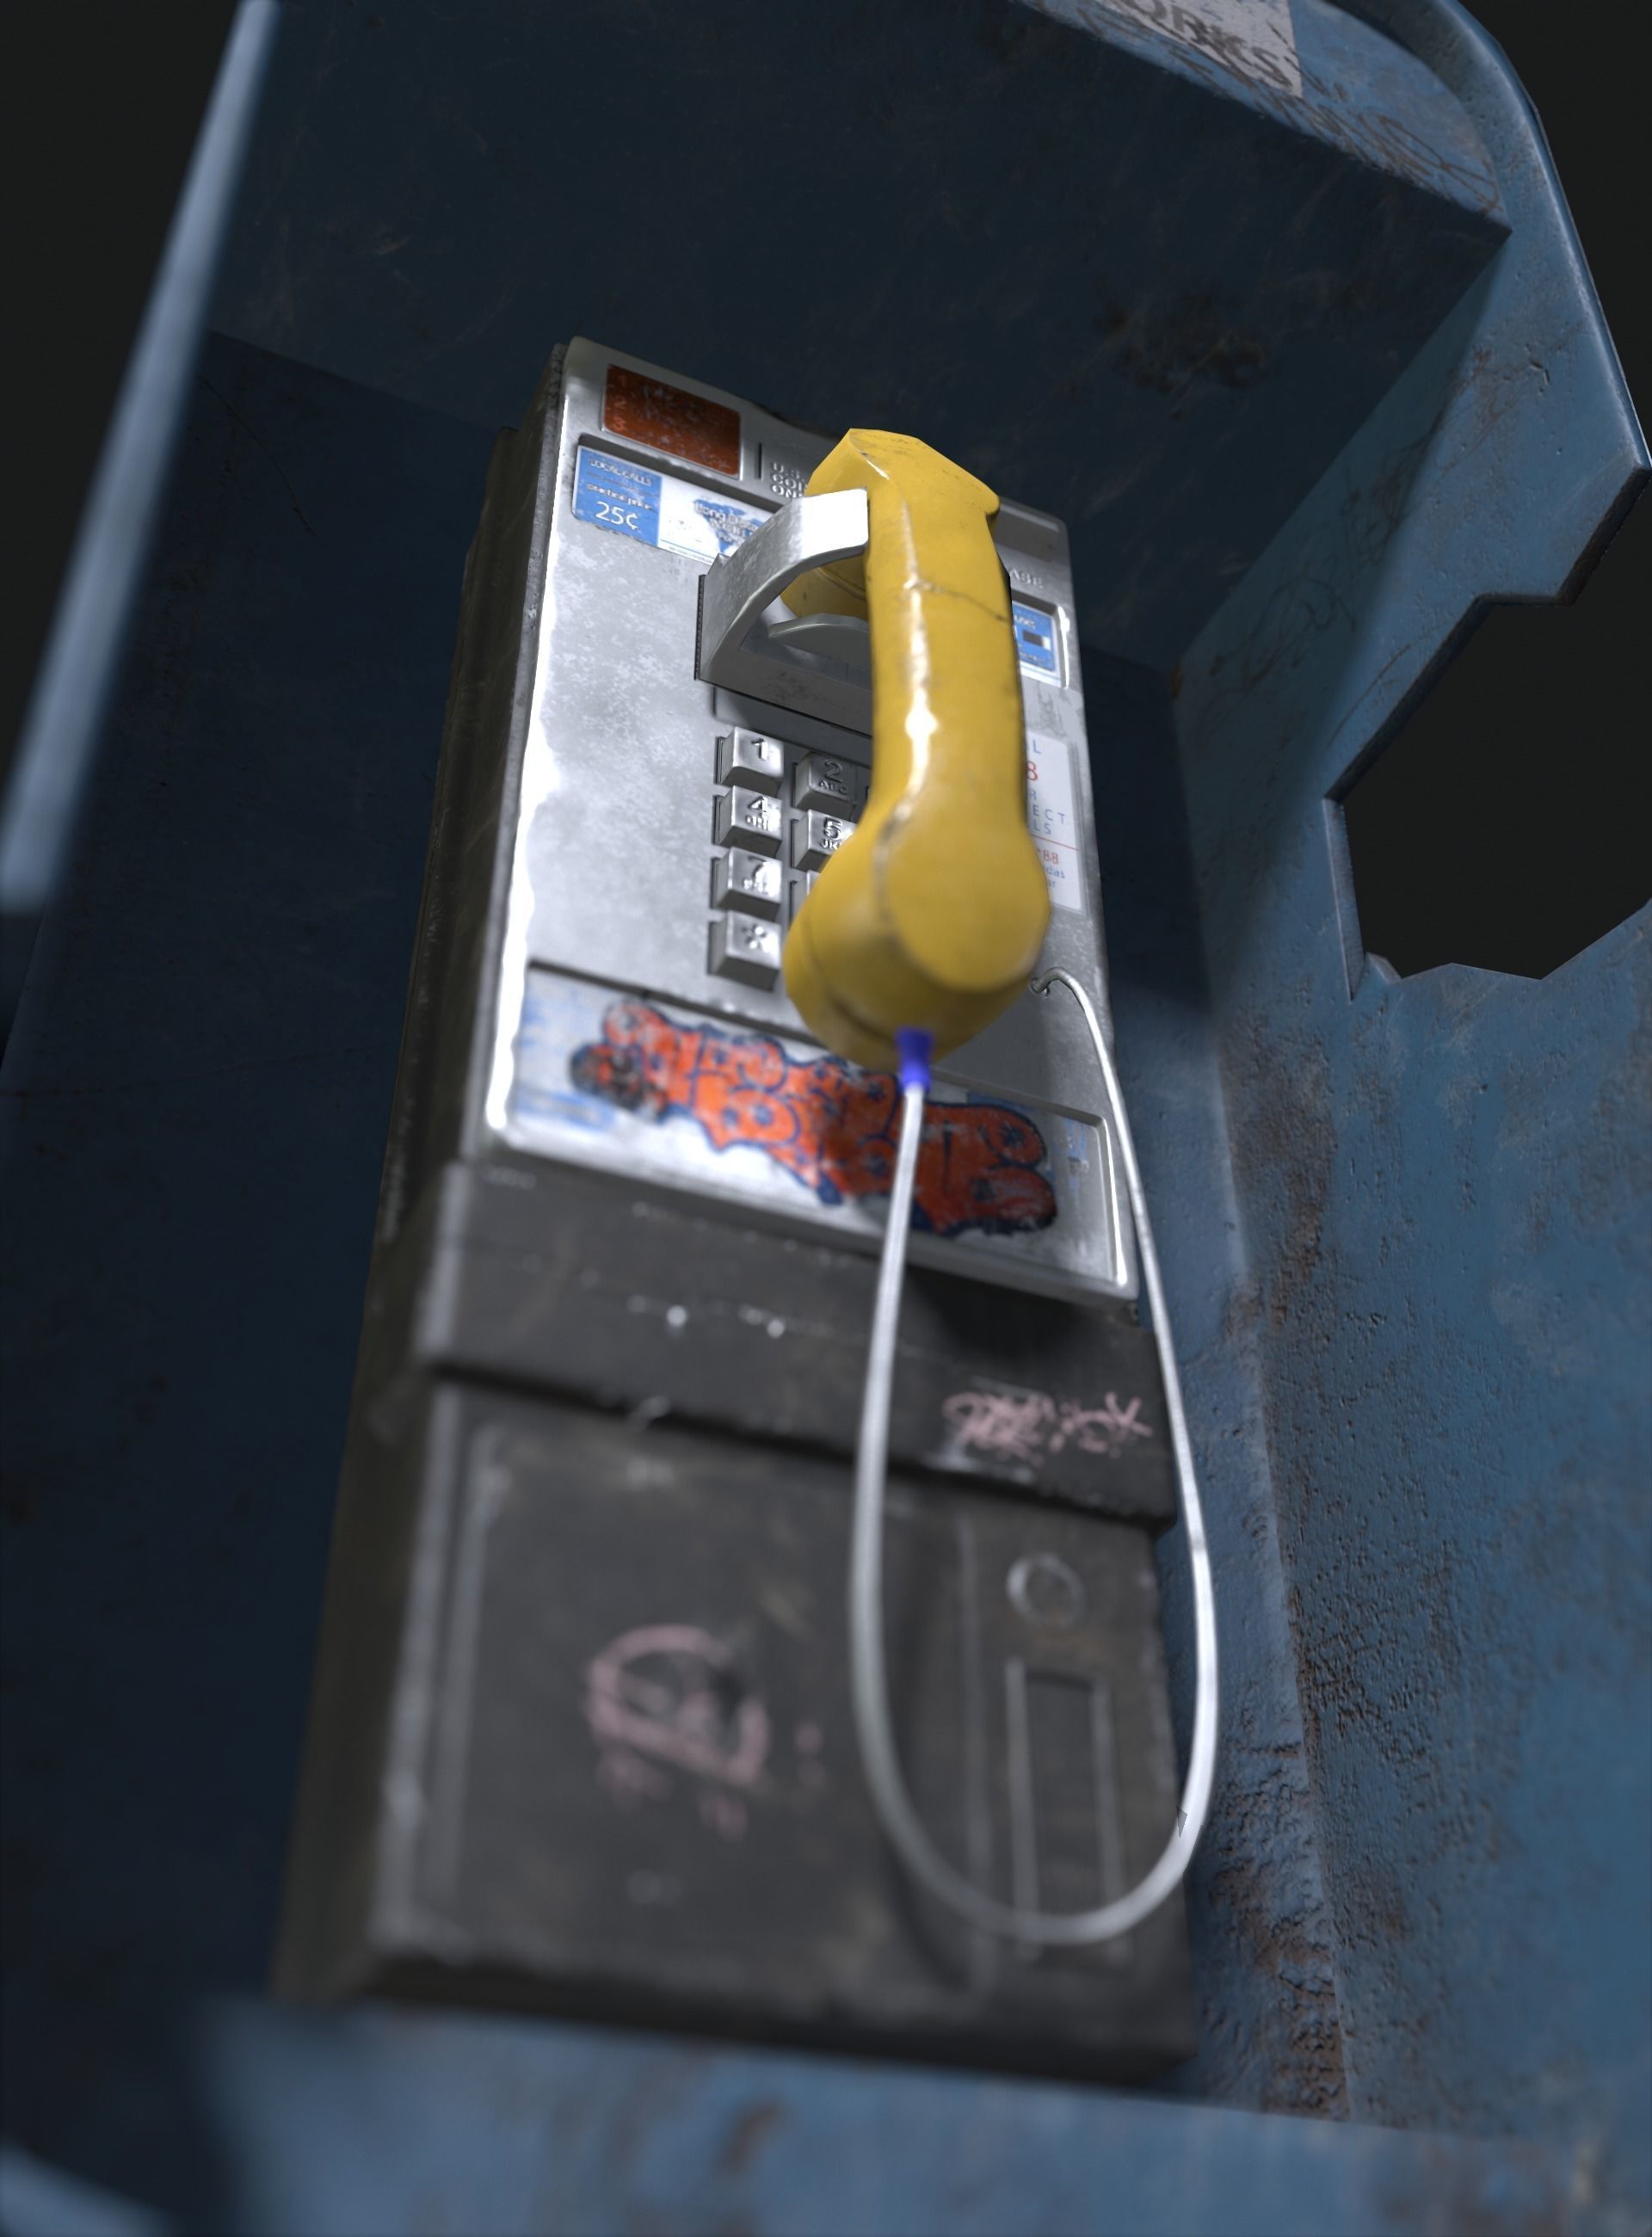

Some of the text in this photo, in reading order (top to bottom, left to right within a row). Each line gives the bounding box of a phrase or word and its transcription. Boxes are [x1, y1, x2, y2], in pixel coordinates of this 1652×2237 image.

[1119, 0, 1293, 88] ORKS
[772, 473, 807, 493] COI
[595, 501, 639, 531] 25¢
[1009, 569, 1044, 589] ASE
[751, 738, 768, 761] 1
[824, 758, 844, 783] 2
[1027, 761, 1039, 781] 8
[748, 796, 769, 814] 4
[1032, 804, 1066, 825] ECT
[823, 817, 842, 840] 5
[1033, 818, 1051, 835] LS
[821, 840, 842, 852] JK
